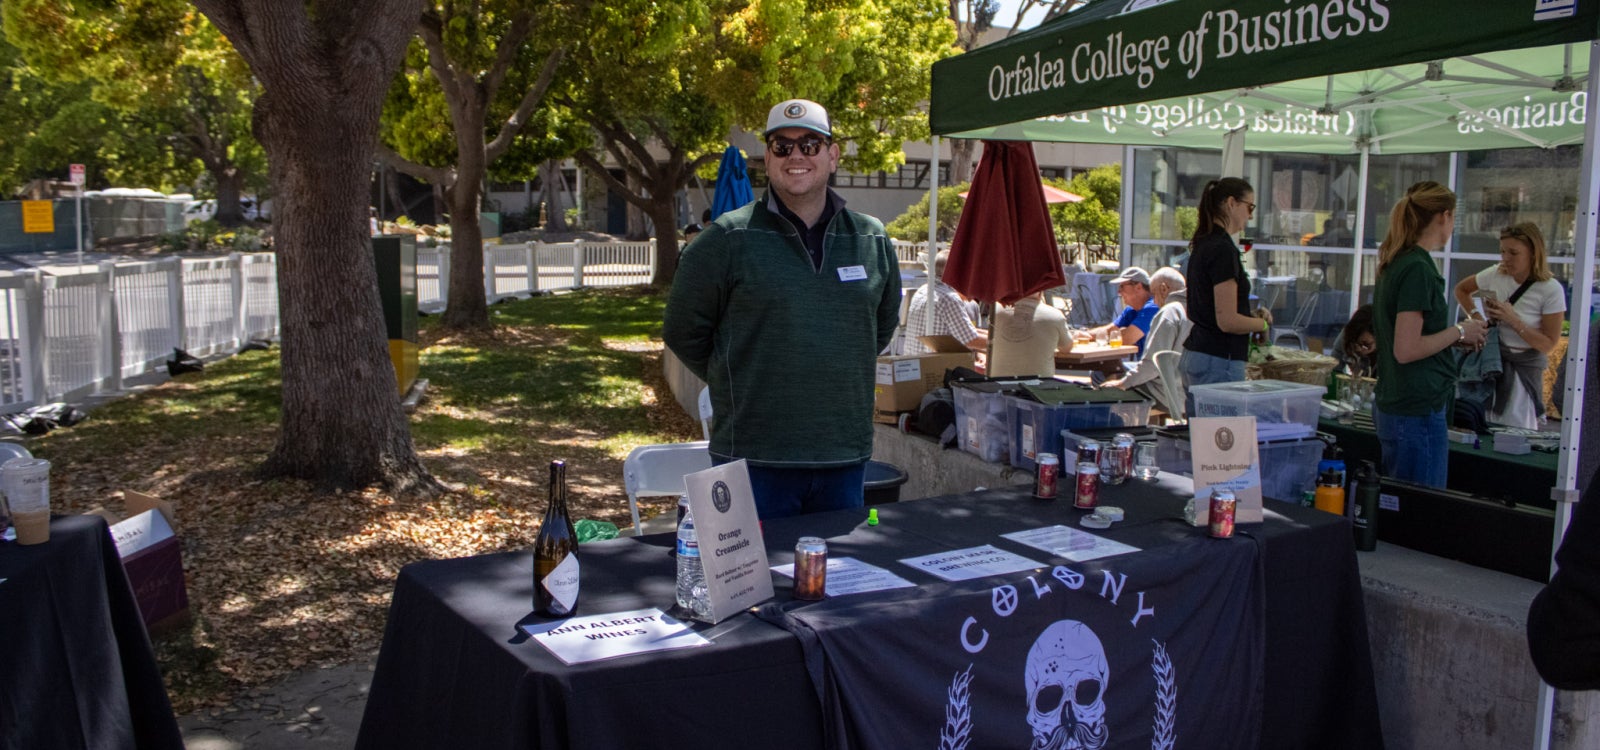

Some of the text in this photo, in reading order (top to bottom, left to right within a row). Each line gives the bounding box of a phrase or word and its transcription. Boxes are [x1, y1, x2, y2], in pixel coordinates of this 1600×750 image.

[988, 0, 1390, 101] Orfalea College of Business
[1219, 463, 1252, 471] Lightning
[116, 528, 143, 542] MISAL
[718, 527, 742, 542] Orange
[715, 538, 750, 557] Creamsicle
[939, 559, 991, 572] BREWING
[960, 565, 1155, 653] COLONY
[547, 615, 657, 637] ANN ALBERT
[585, 628, 648, 641] WINES
